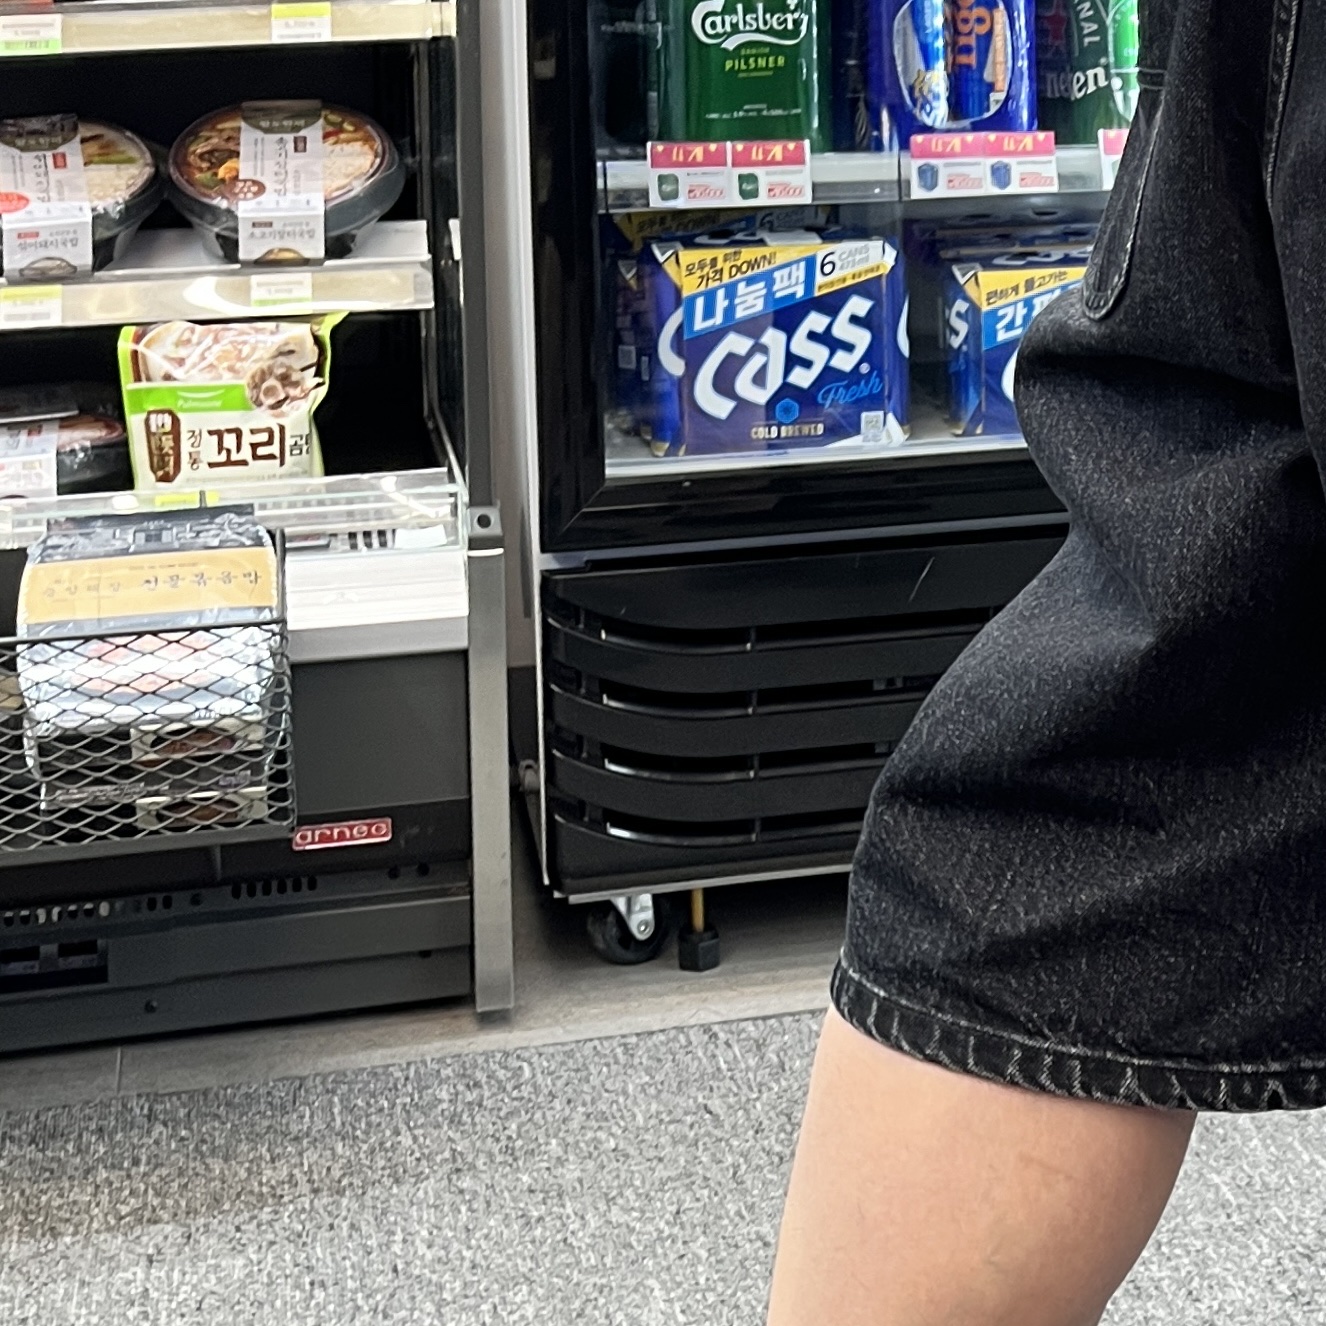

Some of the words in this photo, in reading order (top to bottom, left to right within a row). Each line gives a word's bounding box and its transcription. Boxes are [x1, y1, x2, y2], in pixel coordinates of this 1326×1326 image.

[1074, 0, 1101, 47] NAL
[724, 55, 786, 72] PILSNER
[696, 267, 723, 289] 가격
[820, 251, 836, 277] 6
[693, 261, 806, 331] 나눔팩
[817, 371, 884, 408] Fresh
[206, 422, 286, 469] 꼬리
[751, 424, 778, 439] COLD
